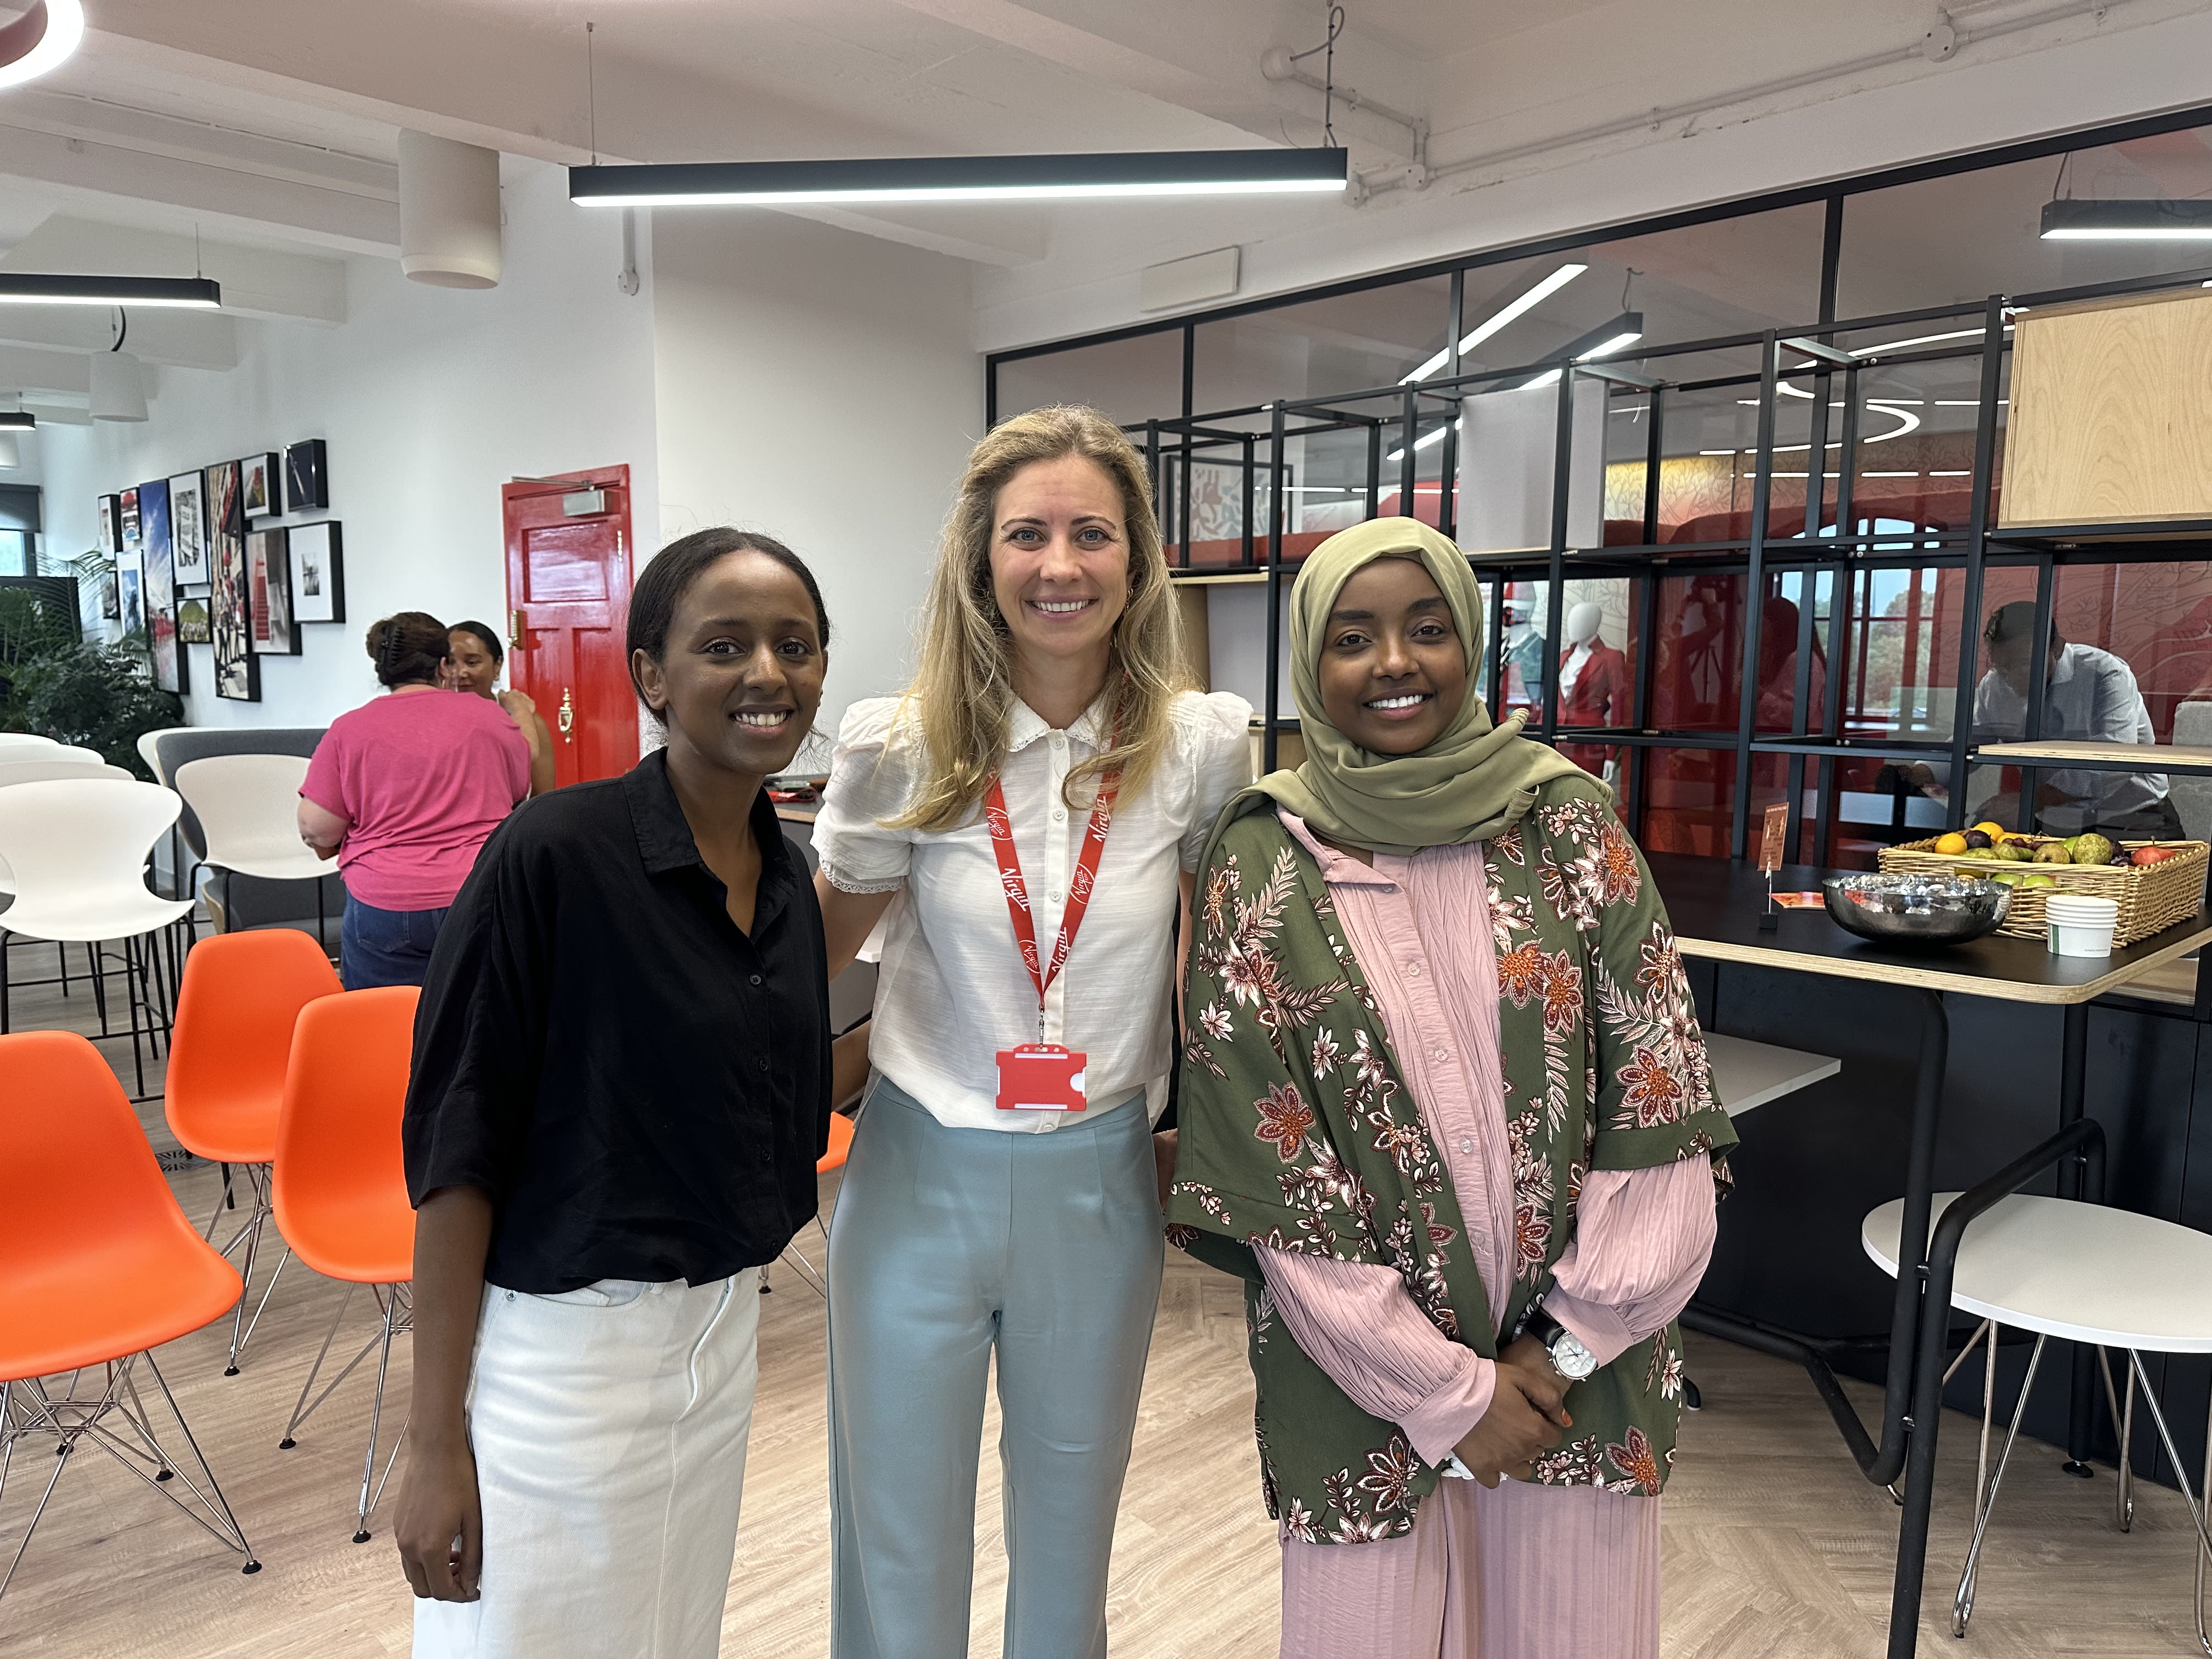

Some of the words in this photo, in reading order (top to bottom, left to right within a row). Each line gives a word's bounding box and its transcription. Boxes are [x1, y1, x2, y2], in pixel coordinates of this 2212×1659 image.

[988, 812, 1007, 836] Virgin
[1088, 795, 1111, 842] Virgin
[1001, 868, 1029, 912] Virgin
[1071, 869, 1093, 895] Virgin
[1023, 945, 1039, 969] Virgin
[1051, 927, 1071, 972] Virgin
